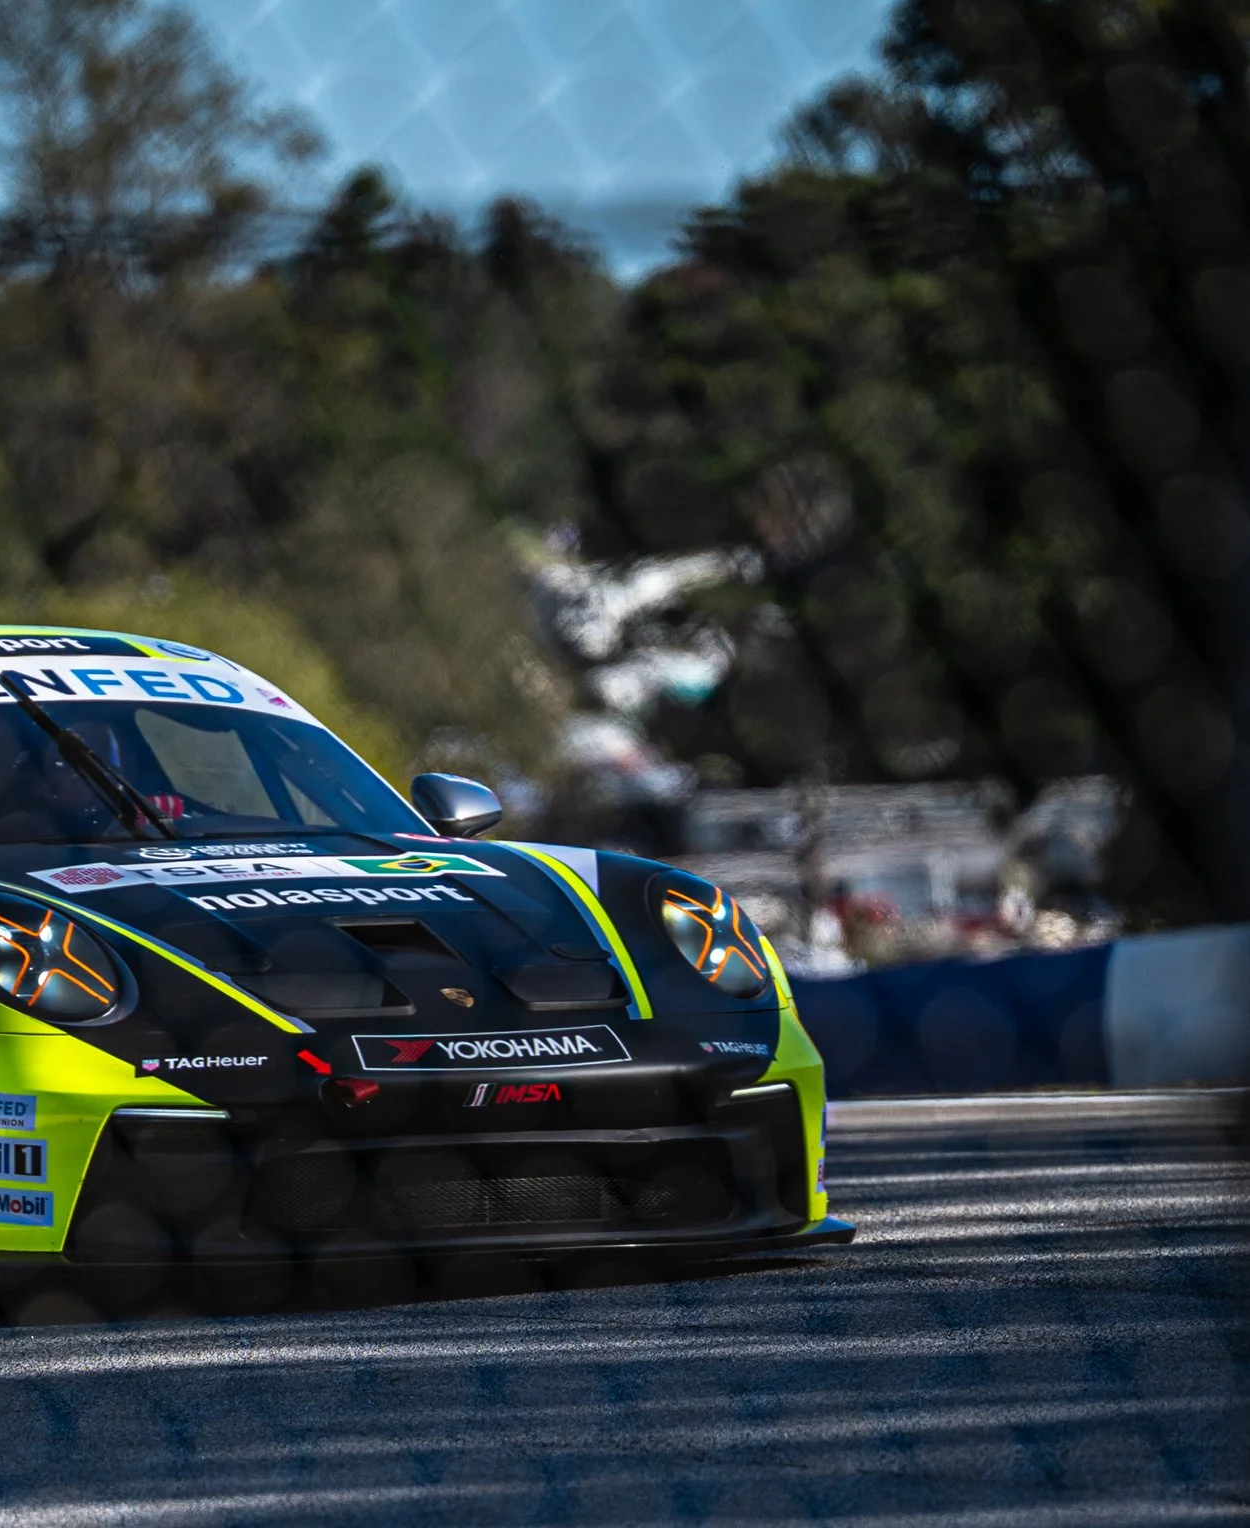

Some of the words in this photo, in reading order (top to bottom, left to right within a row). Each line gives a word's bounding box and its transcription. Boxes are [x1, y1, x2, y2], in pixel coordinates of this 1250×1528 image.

[126, 862, 294, 879] TSEA
[187, 884, 475, 911] nolasport
[436, 1034, 598, 1060] YOKOHAMA
[495, 1083, 562, 1104] IMSA
